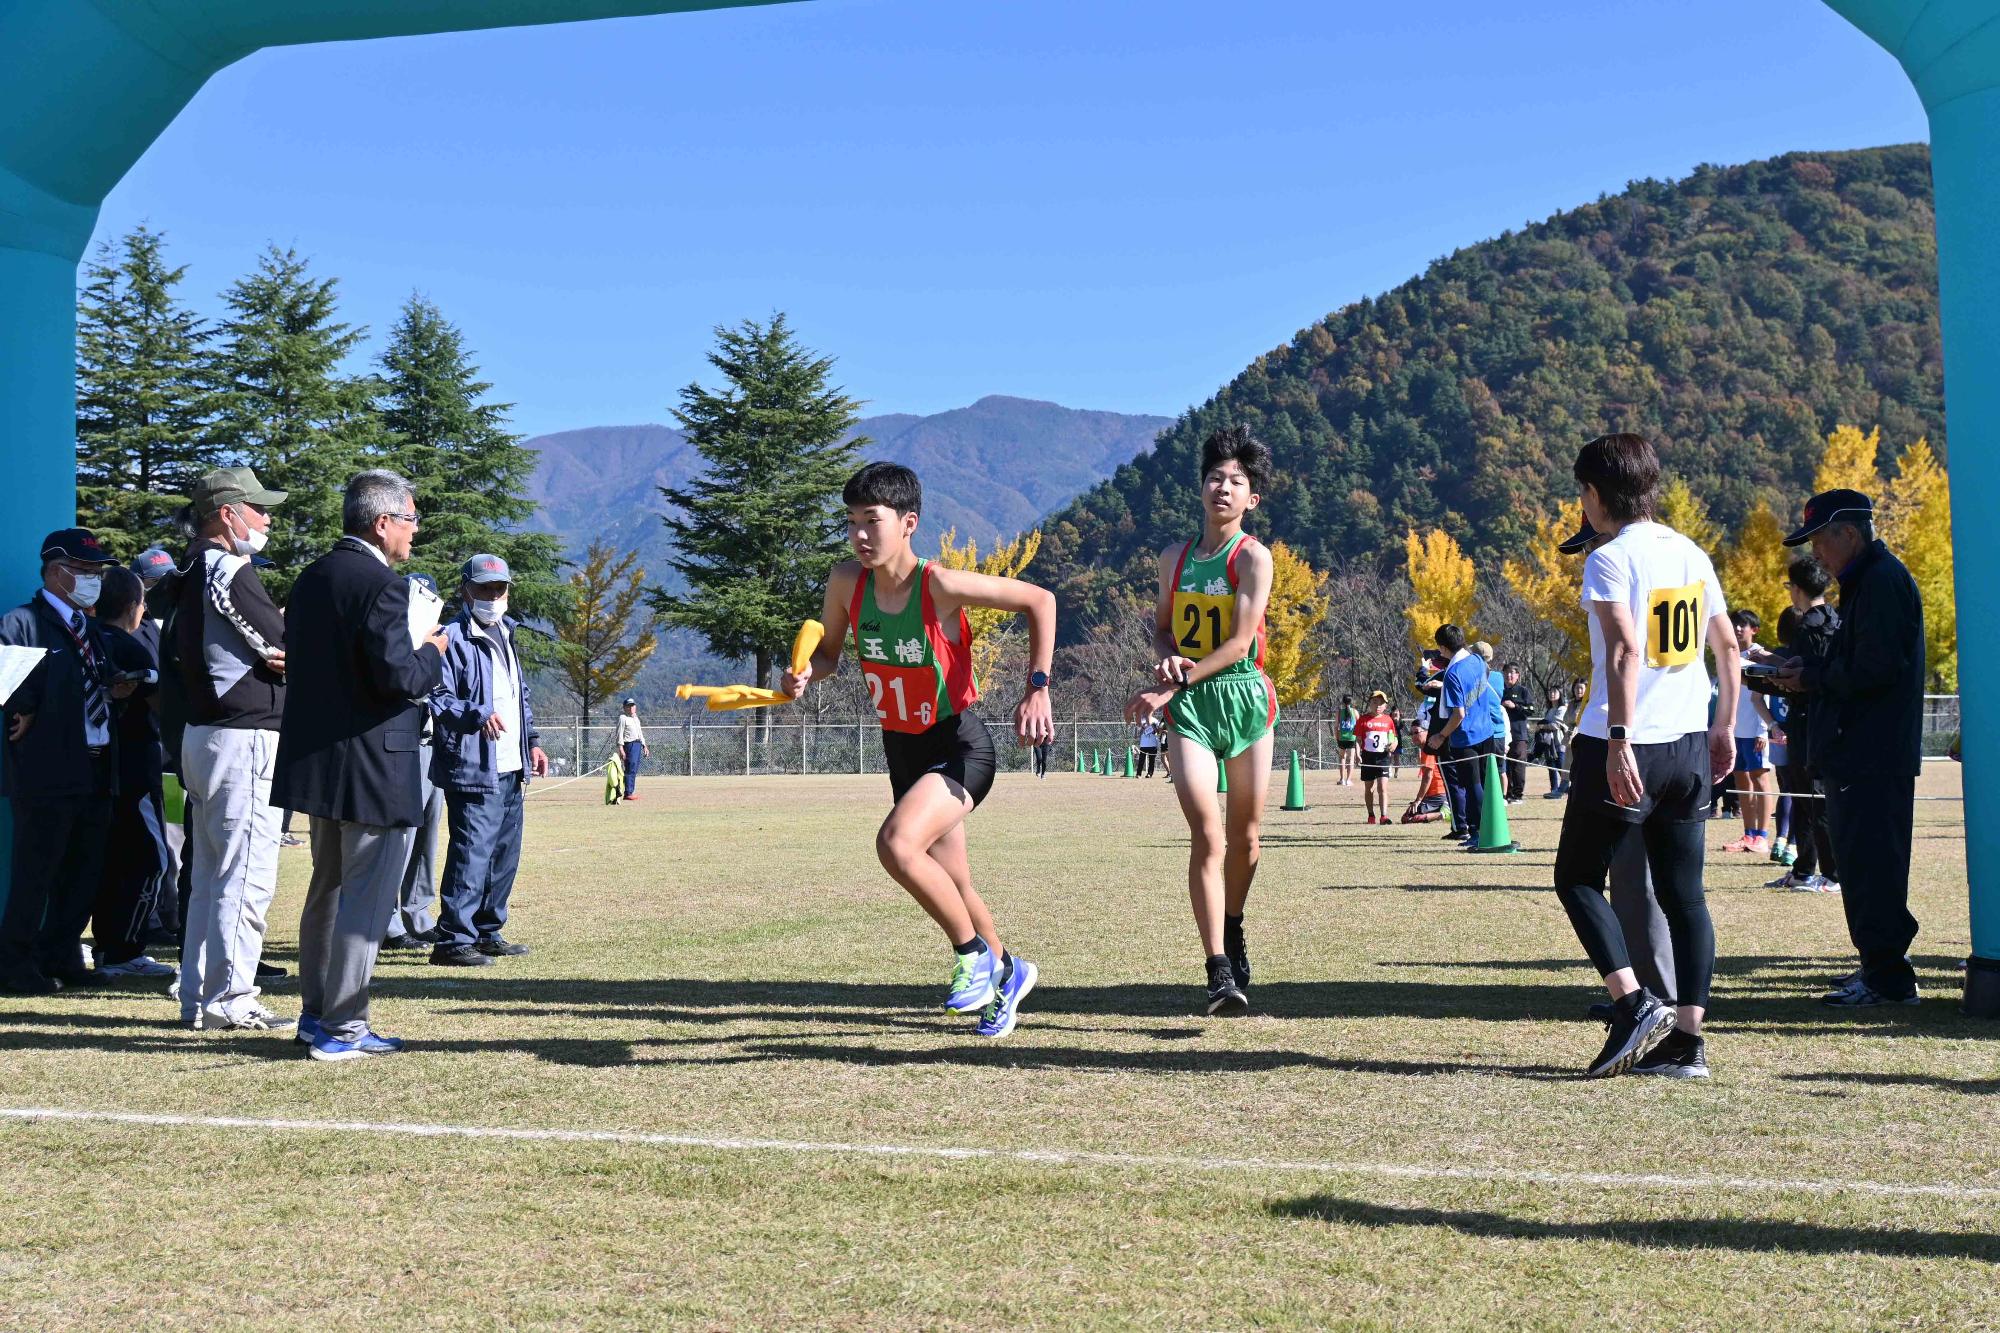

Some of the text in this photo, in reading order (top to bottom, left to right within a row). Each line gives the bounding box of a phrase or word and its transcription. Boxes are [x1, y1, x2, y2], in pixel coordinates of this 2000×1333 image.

[1180, 603, 1220, 650] 21
[1653, 598, 1697, 653] 101
[863, 637, 925, 664] 玉幡
[1372, 734, 1380, 749] 3
